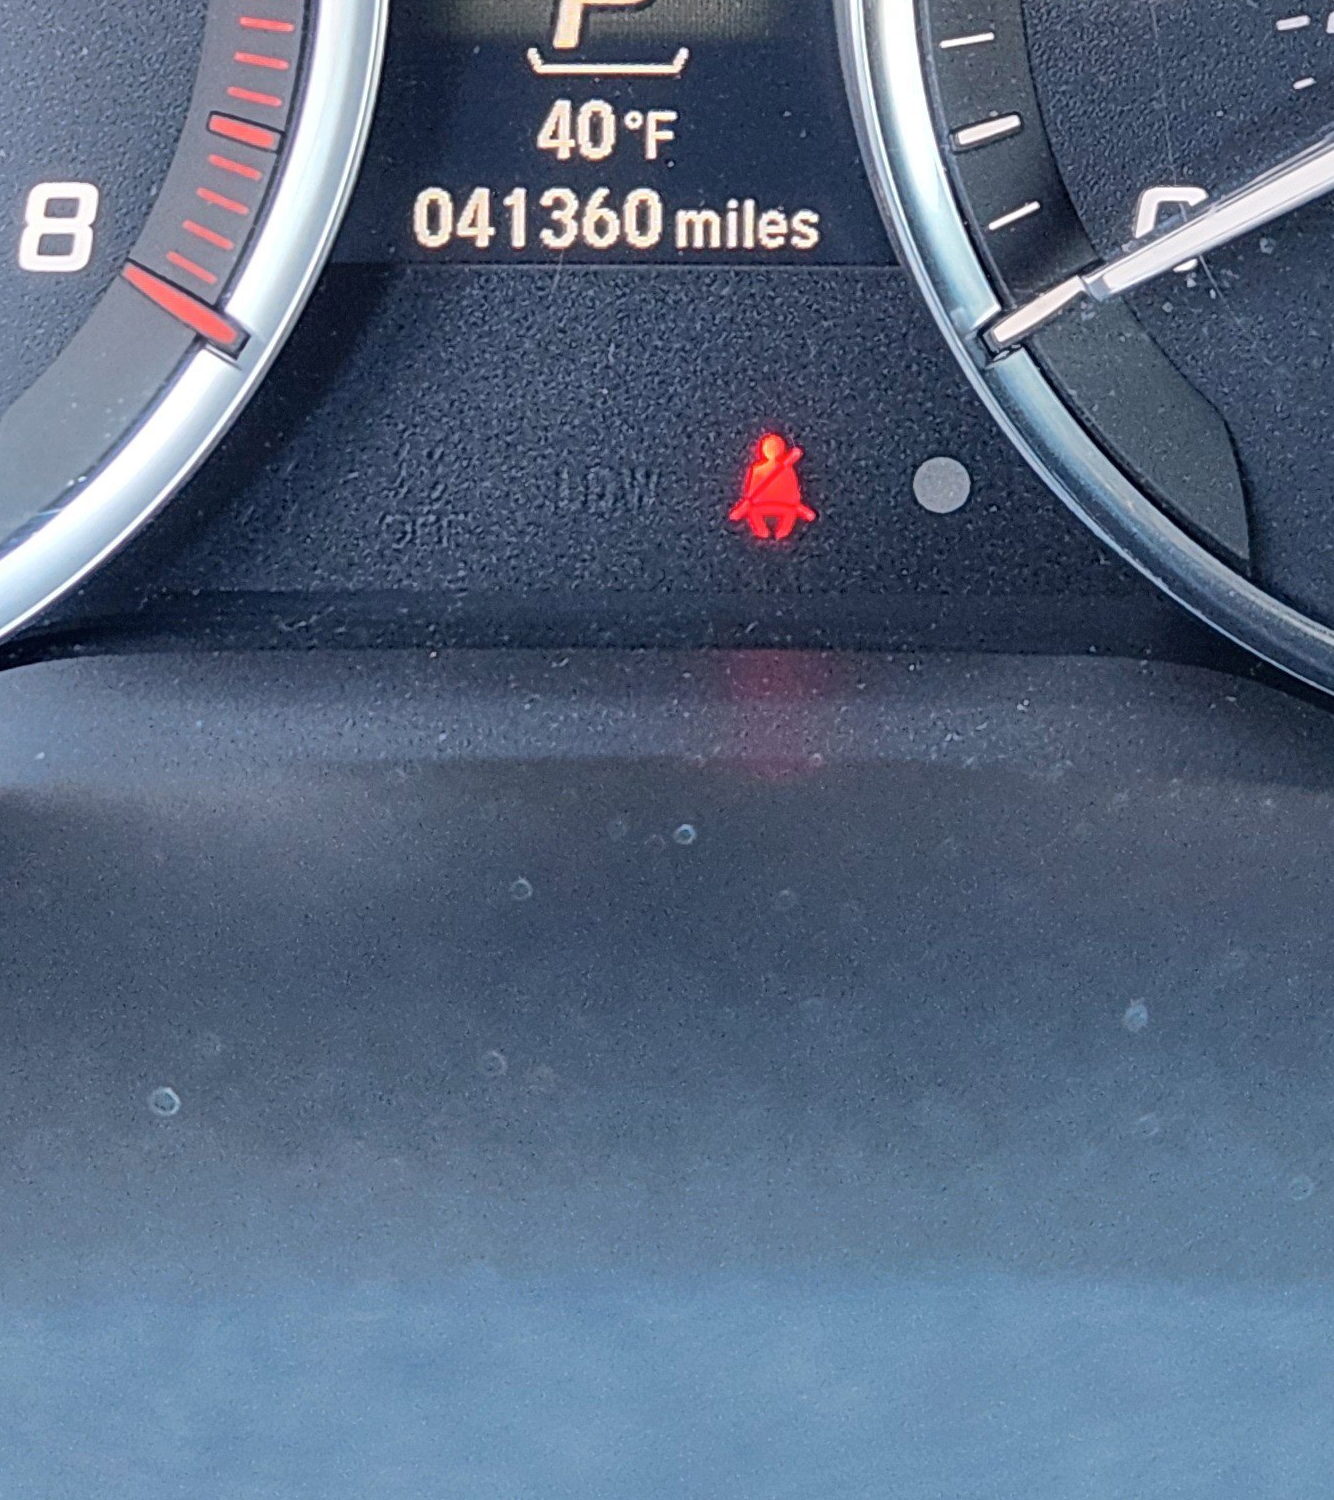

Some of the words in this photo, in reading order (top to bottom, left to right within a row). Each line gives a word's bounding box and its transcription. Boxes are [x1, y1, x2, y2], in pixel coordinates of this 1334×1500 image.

[17, 180, 100, 273] 8
[412, 186, 664, 250] 041360
[674, 197, 820, 250] miles
